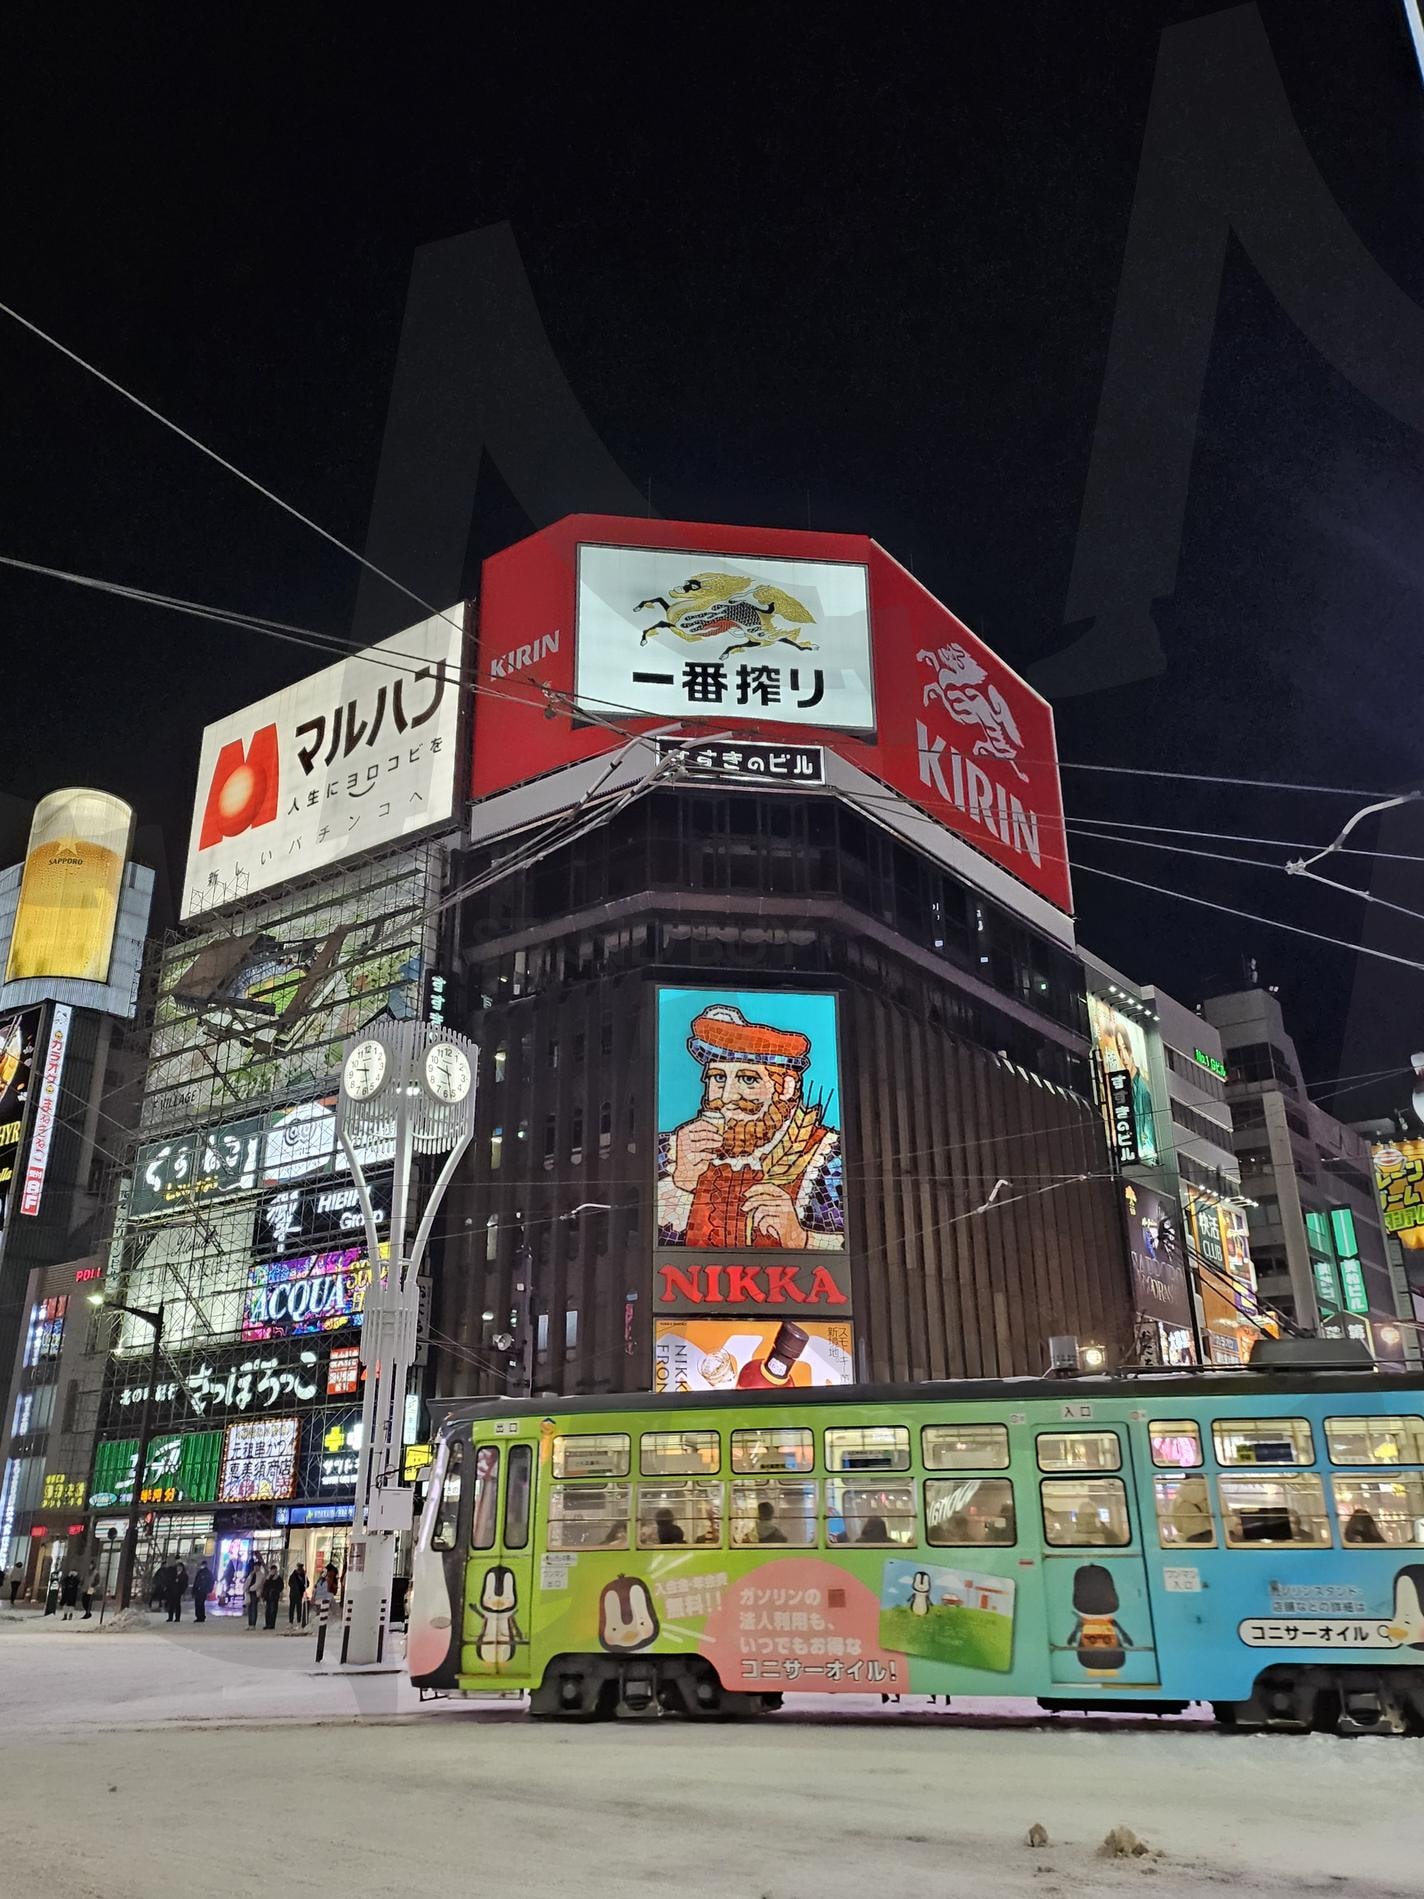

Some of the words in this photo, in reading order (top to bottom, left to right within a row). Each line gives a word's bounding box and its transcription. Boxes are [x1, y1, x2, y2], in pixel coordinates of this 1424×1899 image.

[490, 629, 561, 681] KIRIN
[632, 661, 824, 709] 一番搾り
[295, 657, 447, 777] マルハン
[287, 737, 443, 816] 人生にヨロコビを
[916, 719, 1042, 870] KIRIN
[48, 857, 84, 867] SAPPORO
[47, 1040, 62, 1084] カラオケ
[1110, 1074, 1136, 1162] すすきのビル
[339, 1210, 384, 1230] Grop
[1200, 1210, 1220, 1241] 快活
[1203, 1242, 1223, 1262] CLUB
[657, 1263, 848, 1304] NIKKA
[250, 1275, 347, 1323] ACQUA
[186, 1351, 317, 1417] さっぽろっこ
[1064, 1406, 1091, 1417] 入口
[496, 1423, 518, 1433] 出口
[740, 1588, 821, 1606] ガソリンの
[1173, 1580, 1194, 1590] 入口
[739, 1611, 835, 1631] 法人利用も、
[1252, 1626, 1369, 1641] コニサーオイル
[740, 1637, 862, 1656] いつでもお得な
[741, 1659, 898, 1682] コニサーオイル!
